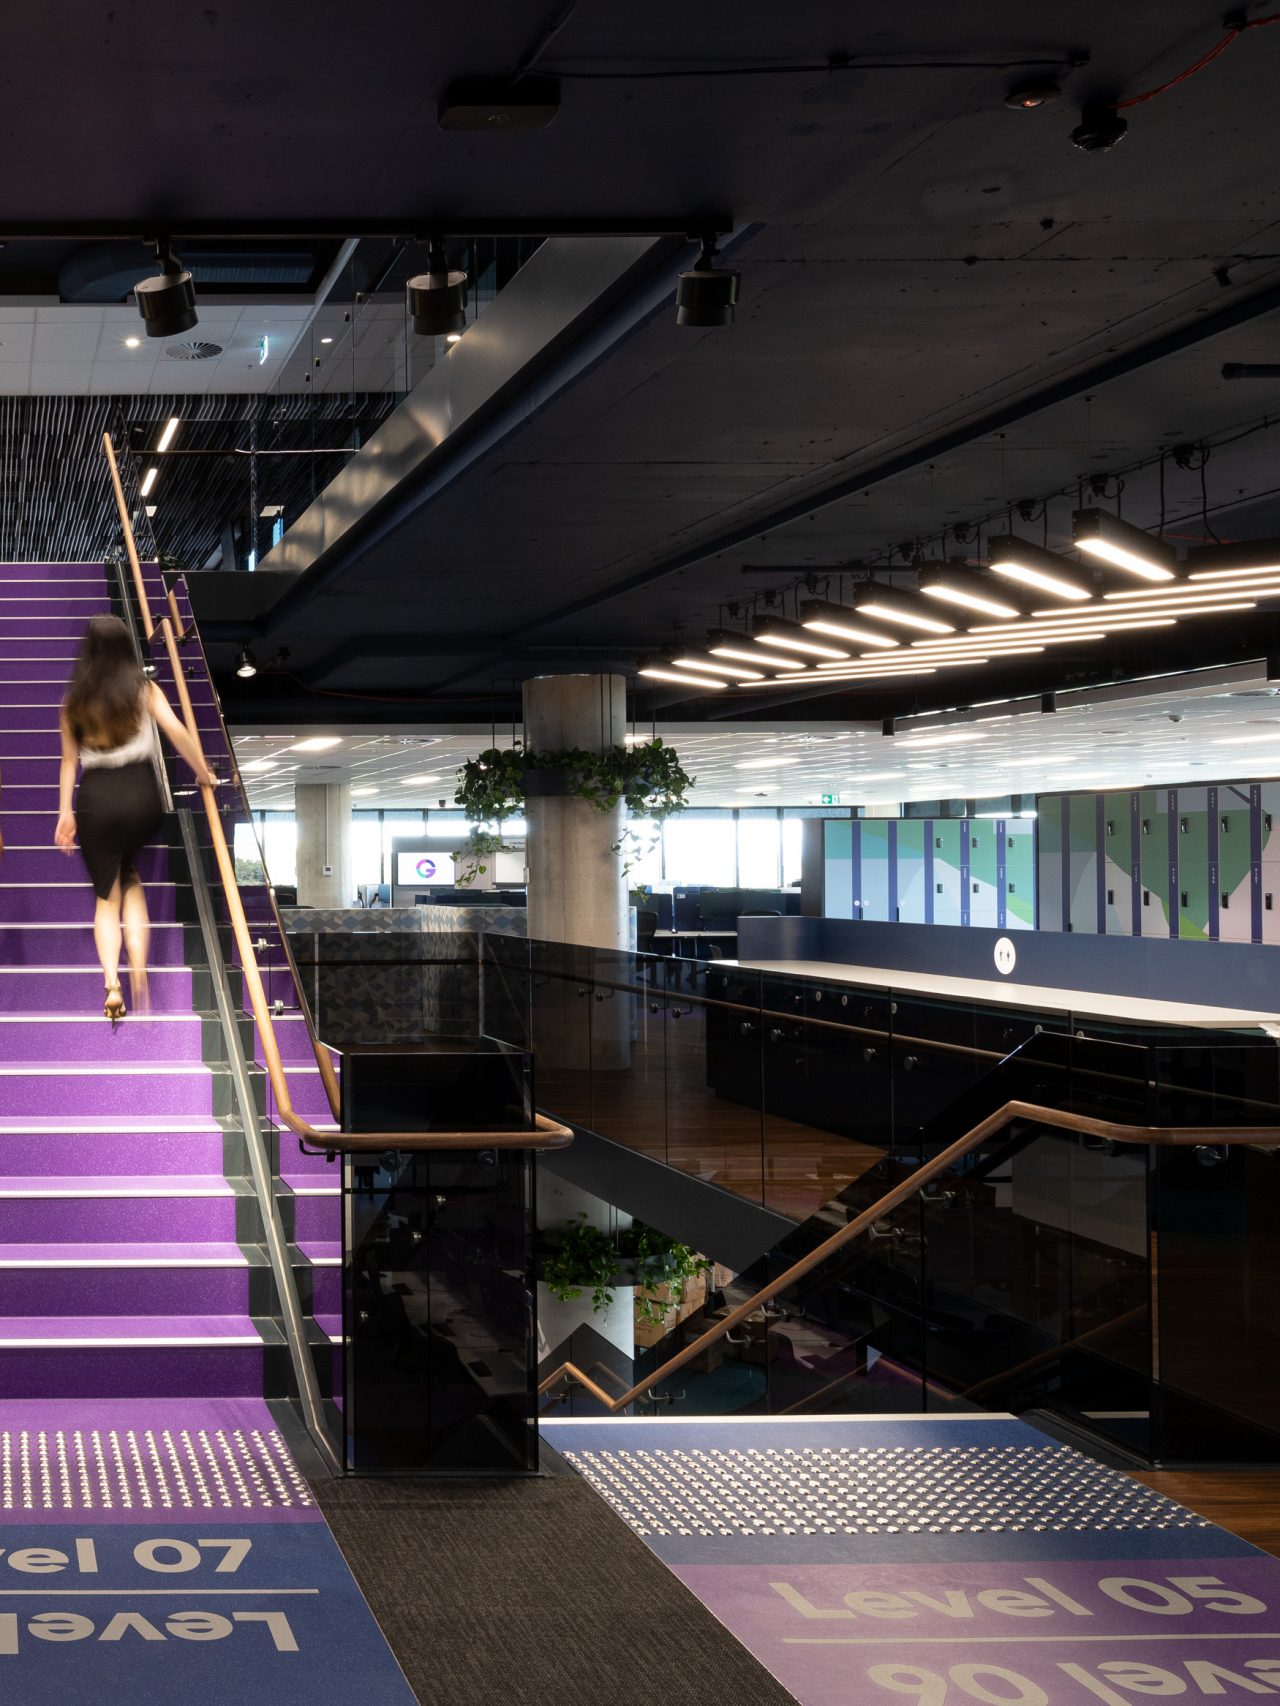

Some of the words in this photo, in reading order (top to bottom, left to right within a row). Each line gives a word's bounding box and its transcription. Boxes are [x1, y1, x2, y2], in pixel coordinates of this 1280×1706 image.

[133, 1538, 253, 1575] 07
[768, 1577, 1095, 1619] Level
[1097, 1576, 1268, 1615] 05
